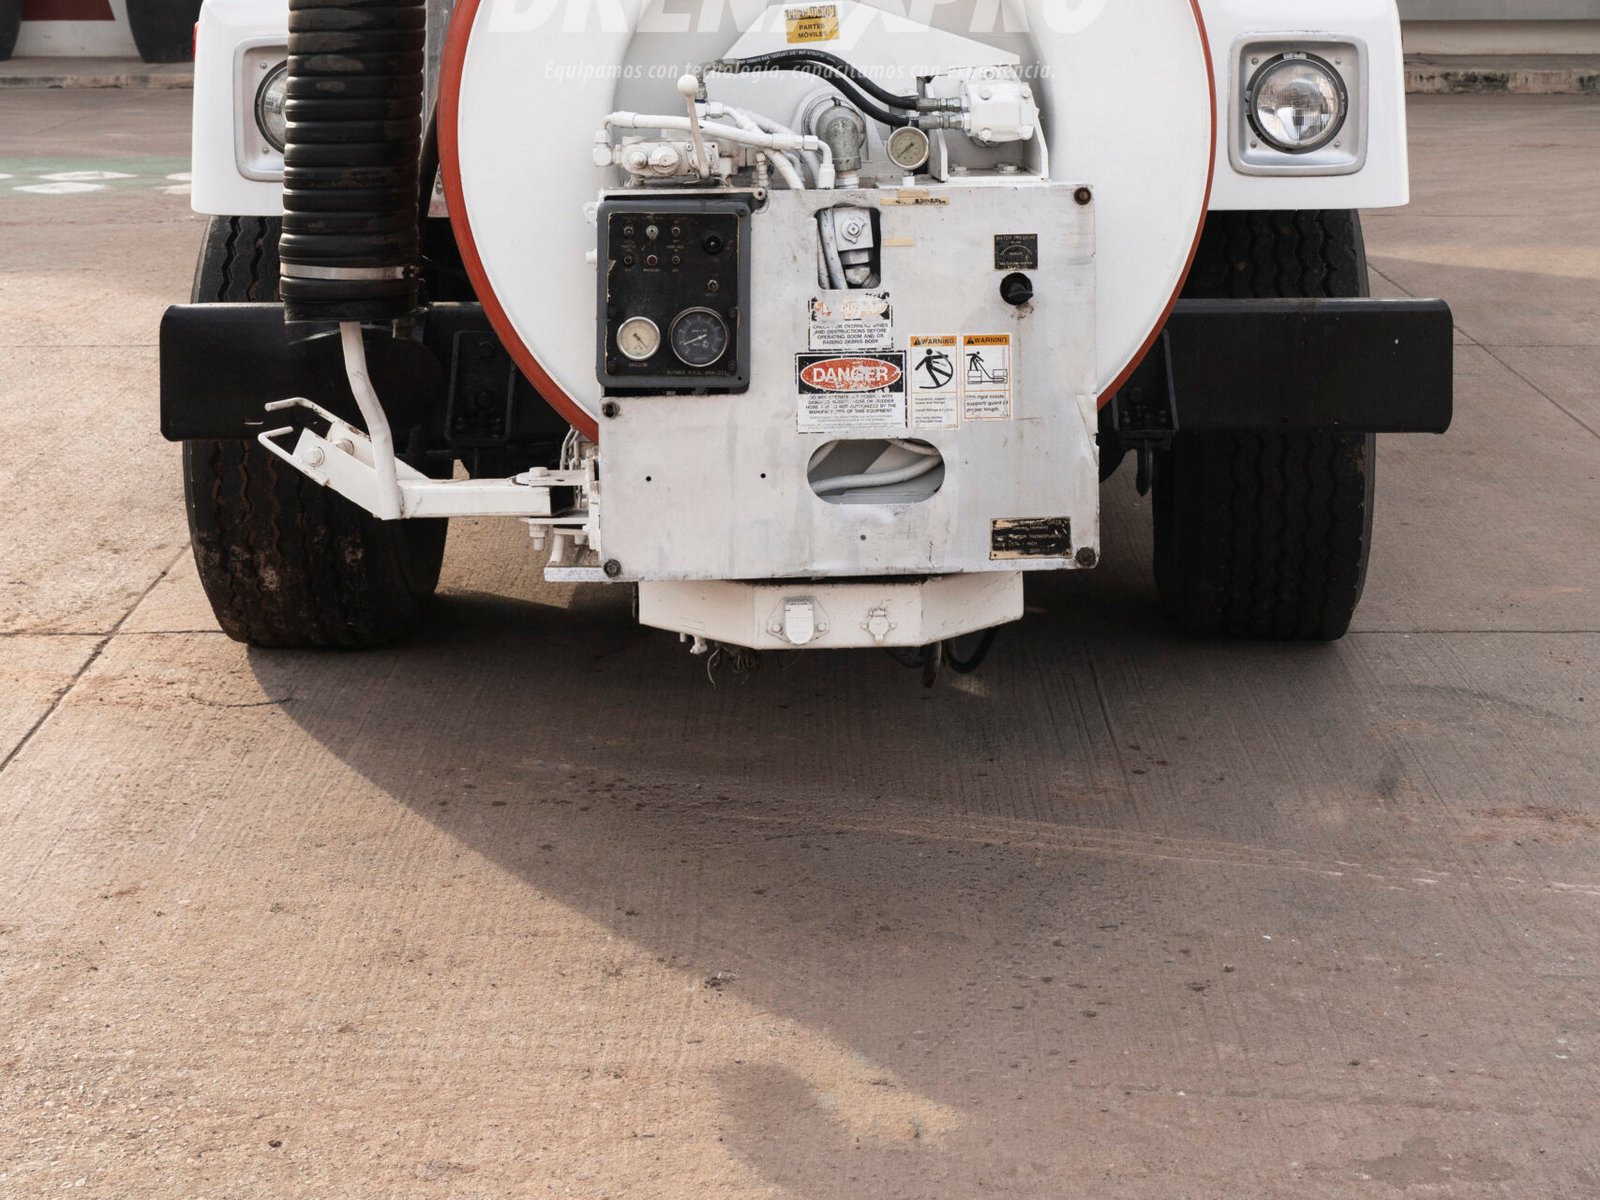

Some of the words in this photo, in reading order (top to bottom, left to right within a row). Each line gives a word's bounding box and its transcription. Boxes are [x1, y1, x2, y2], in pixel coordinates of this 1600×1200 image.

[799, 23, 826, 31] PARTES
[921, 337, 955, 345] WARNING
[974, 336, 1008, 344] WARNING
[812, 366, 889, 383] DANGER
